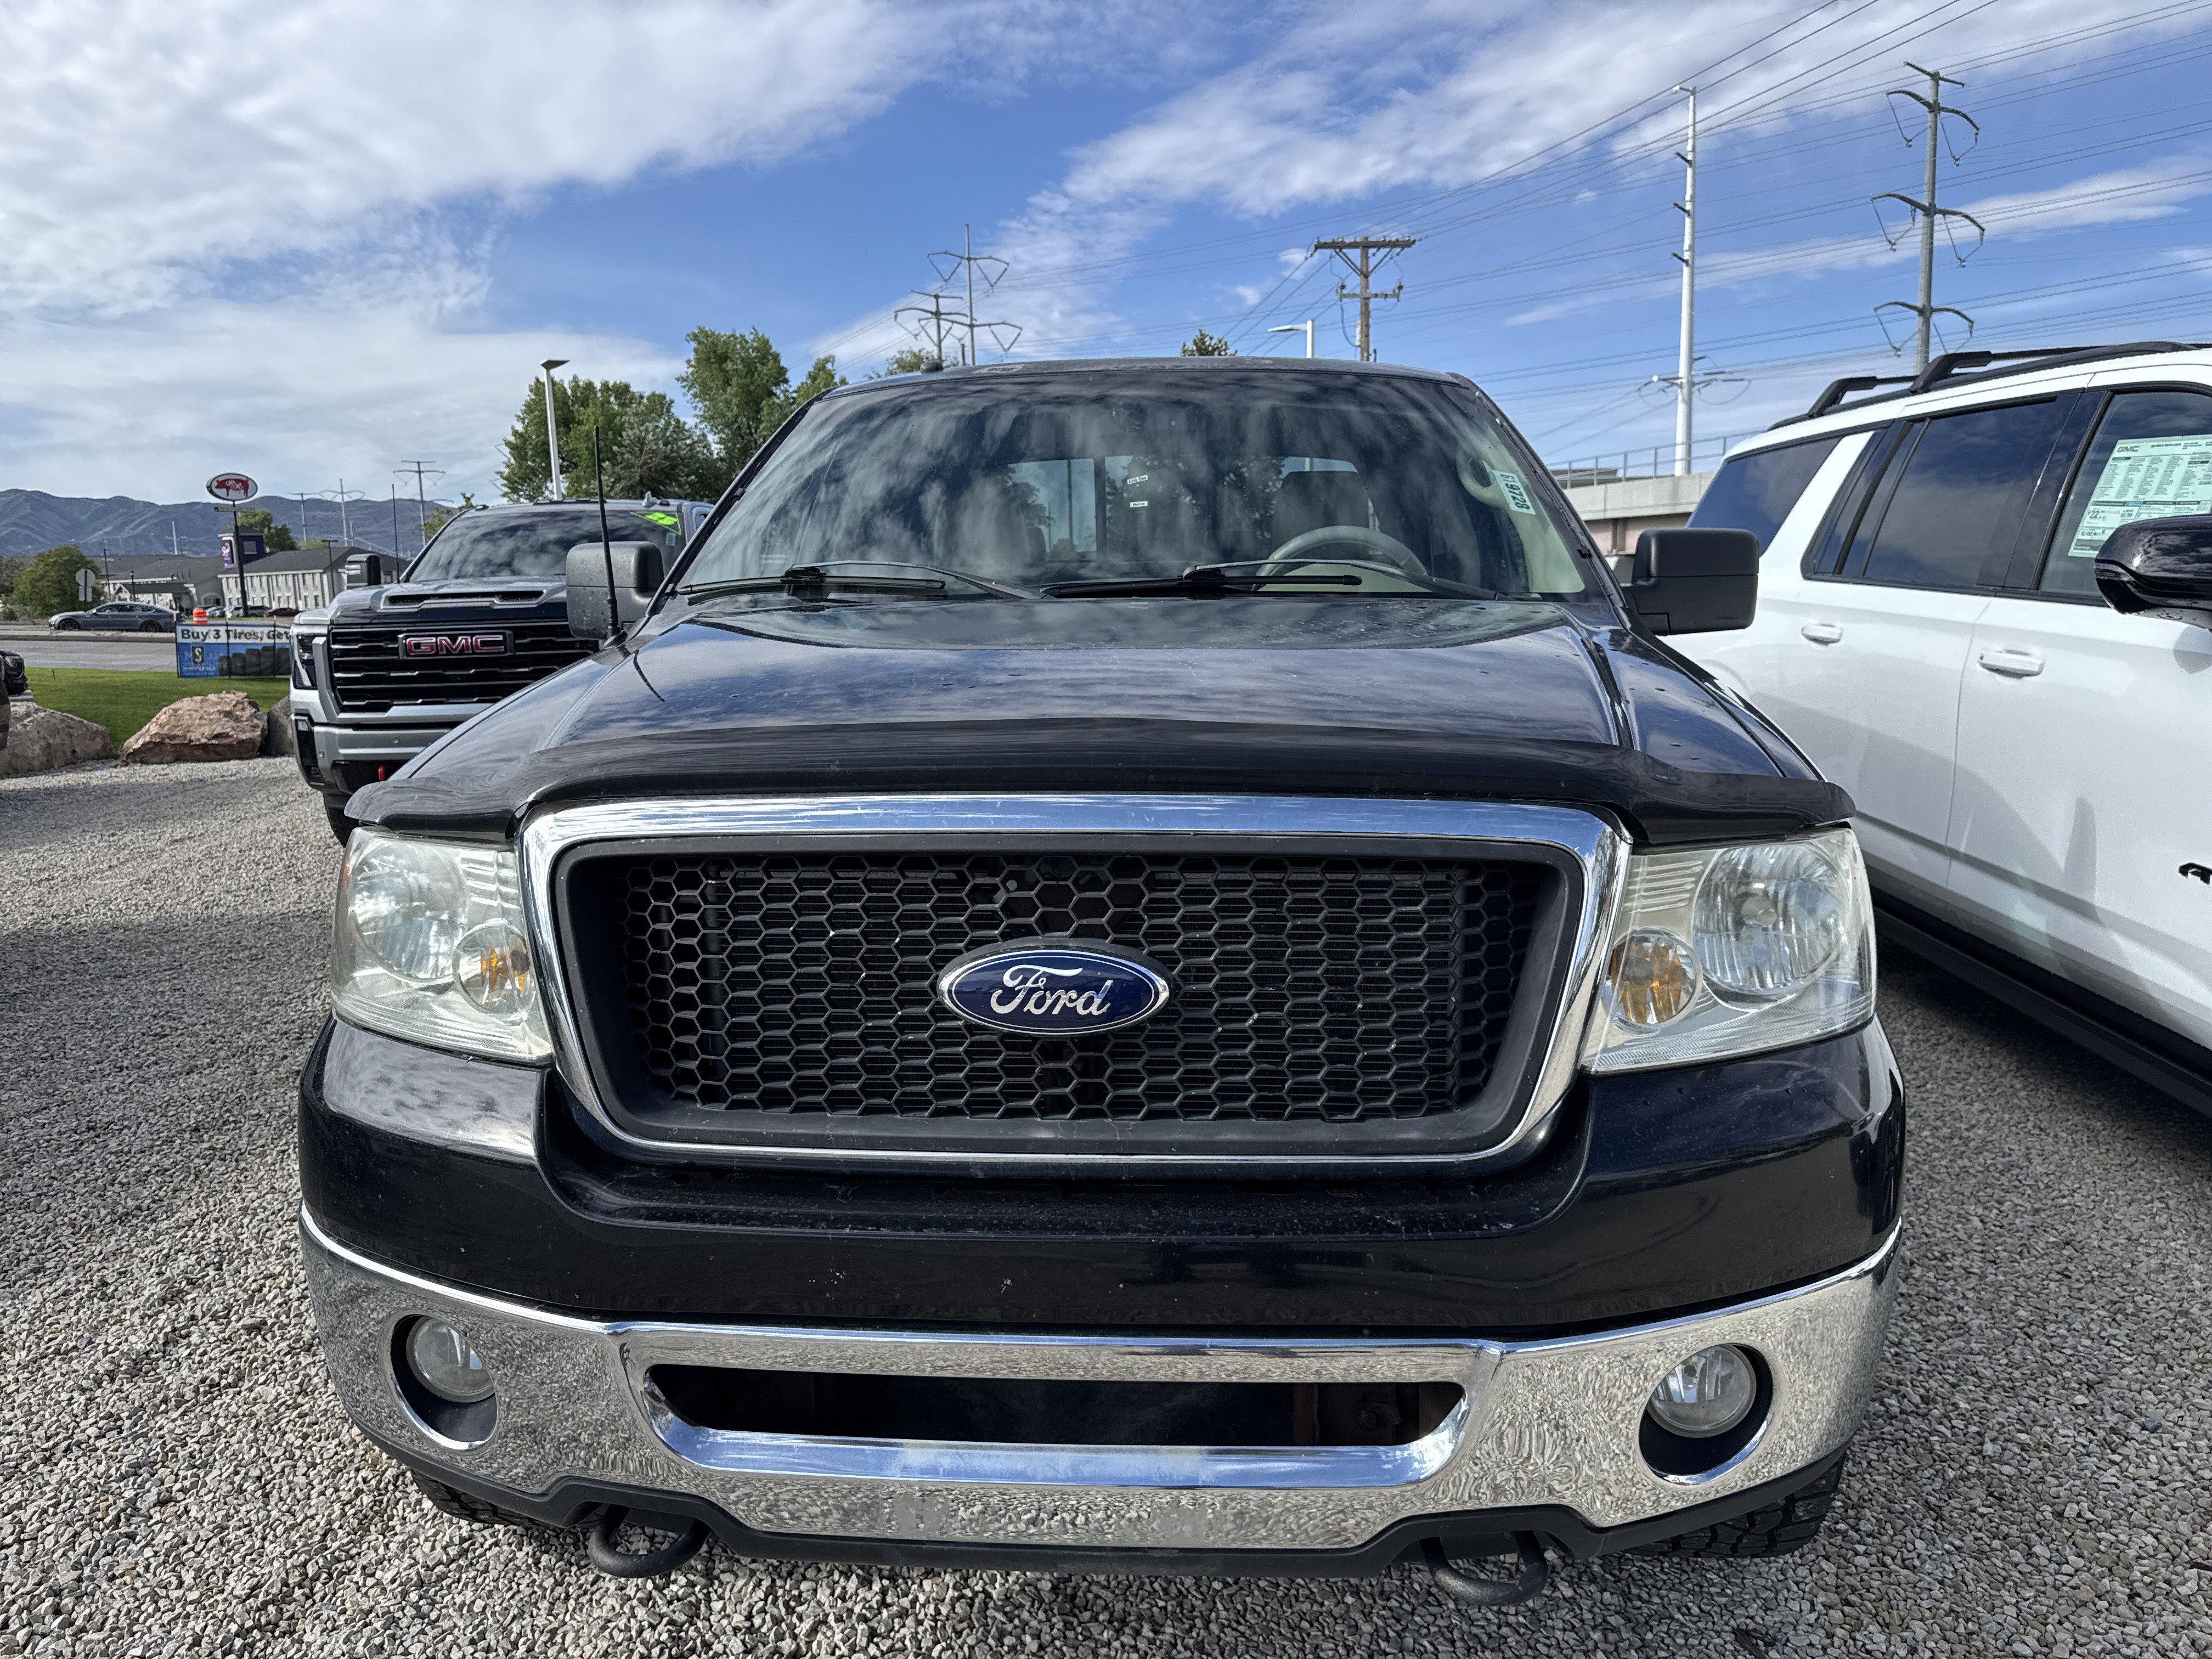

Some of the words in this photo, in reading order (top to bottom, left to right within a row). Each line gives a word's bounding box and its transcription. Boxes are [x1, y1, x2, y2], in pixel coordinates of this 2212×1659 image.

[1499, 473, 1531, 510] 619728
[181, 629, 209, 641] Buy
[213, 629, 221, 640] 3
[225, 629, 263, 641] Tires,
[266, 630, 290, 640] Get
[406, 634, 505, 656] GMC
[990, 964, 1114, 1016] Ford
